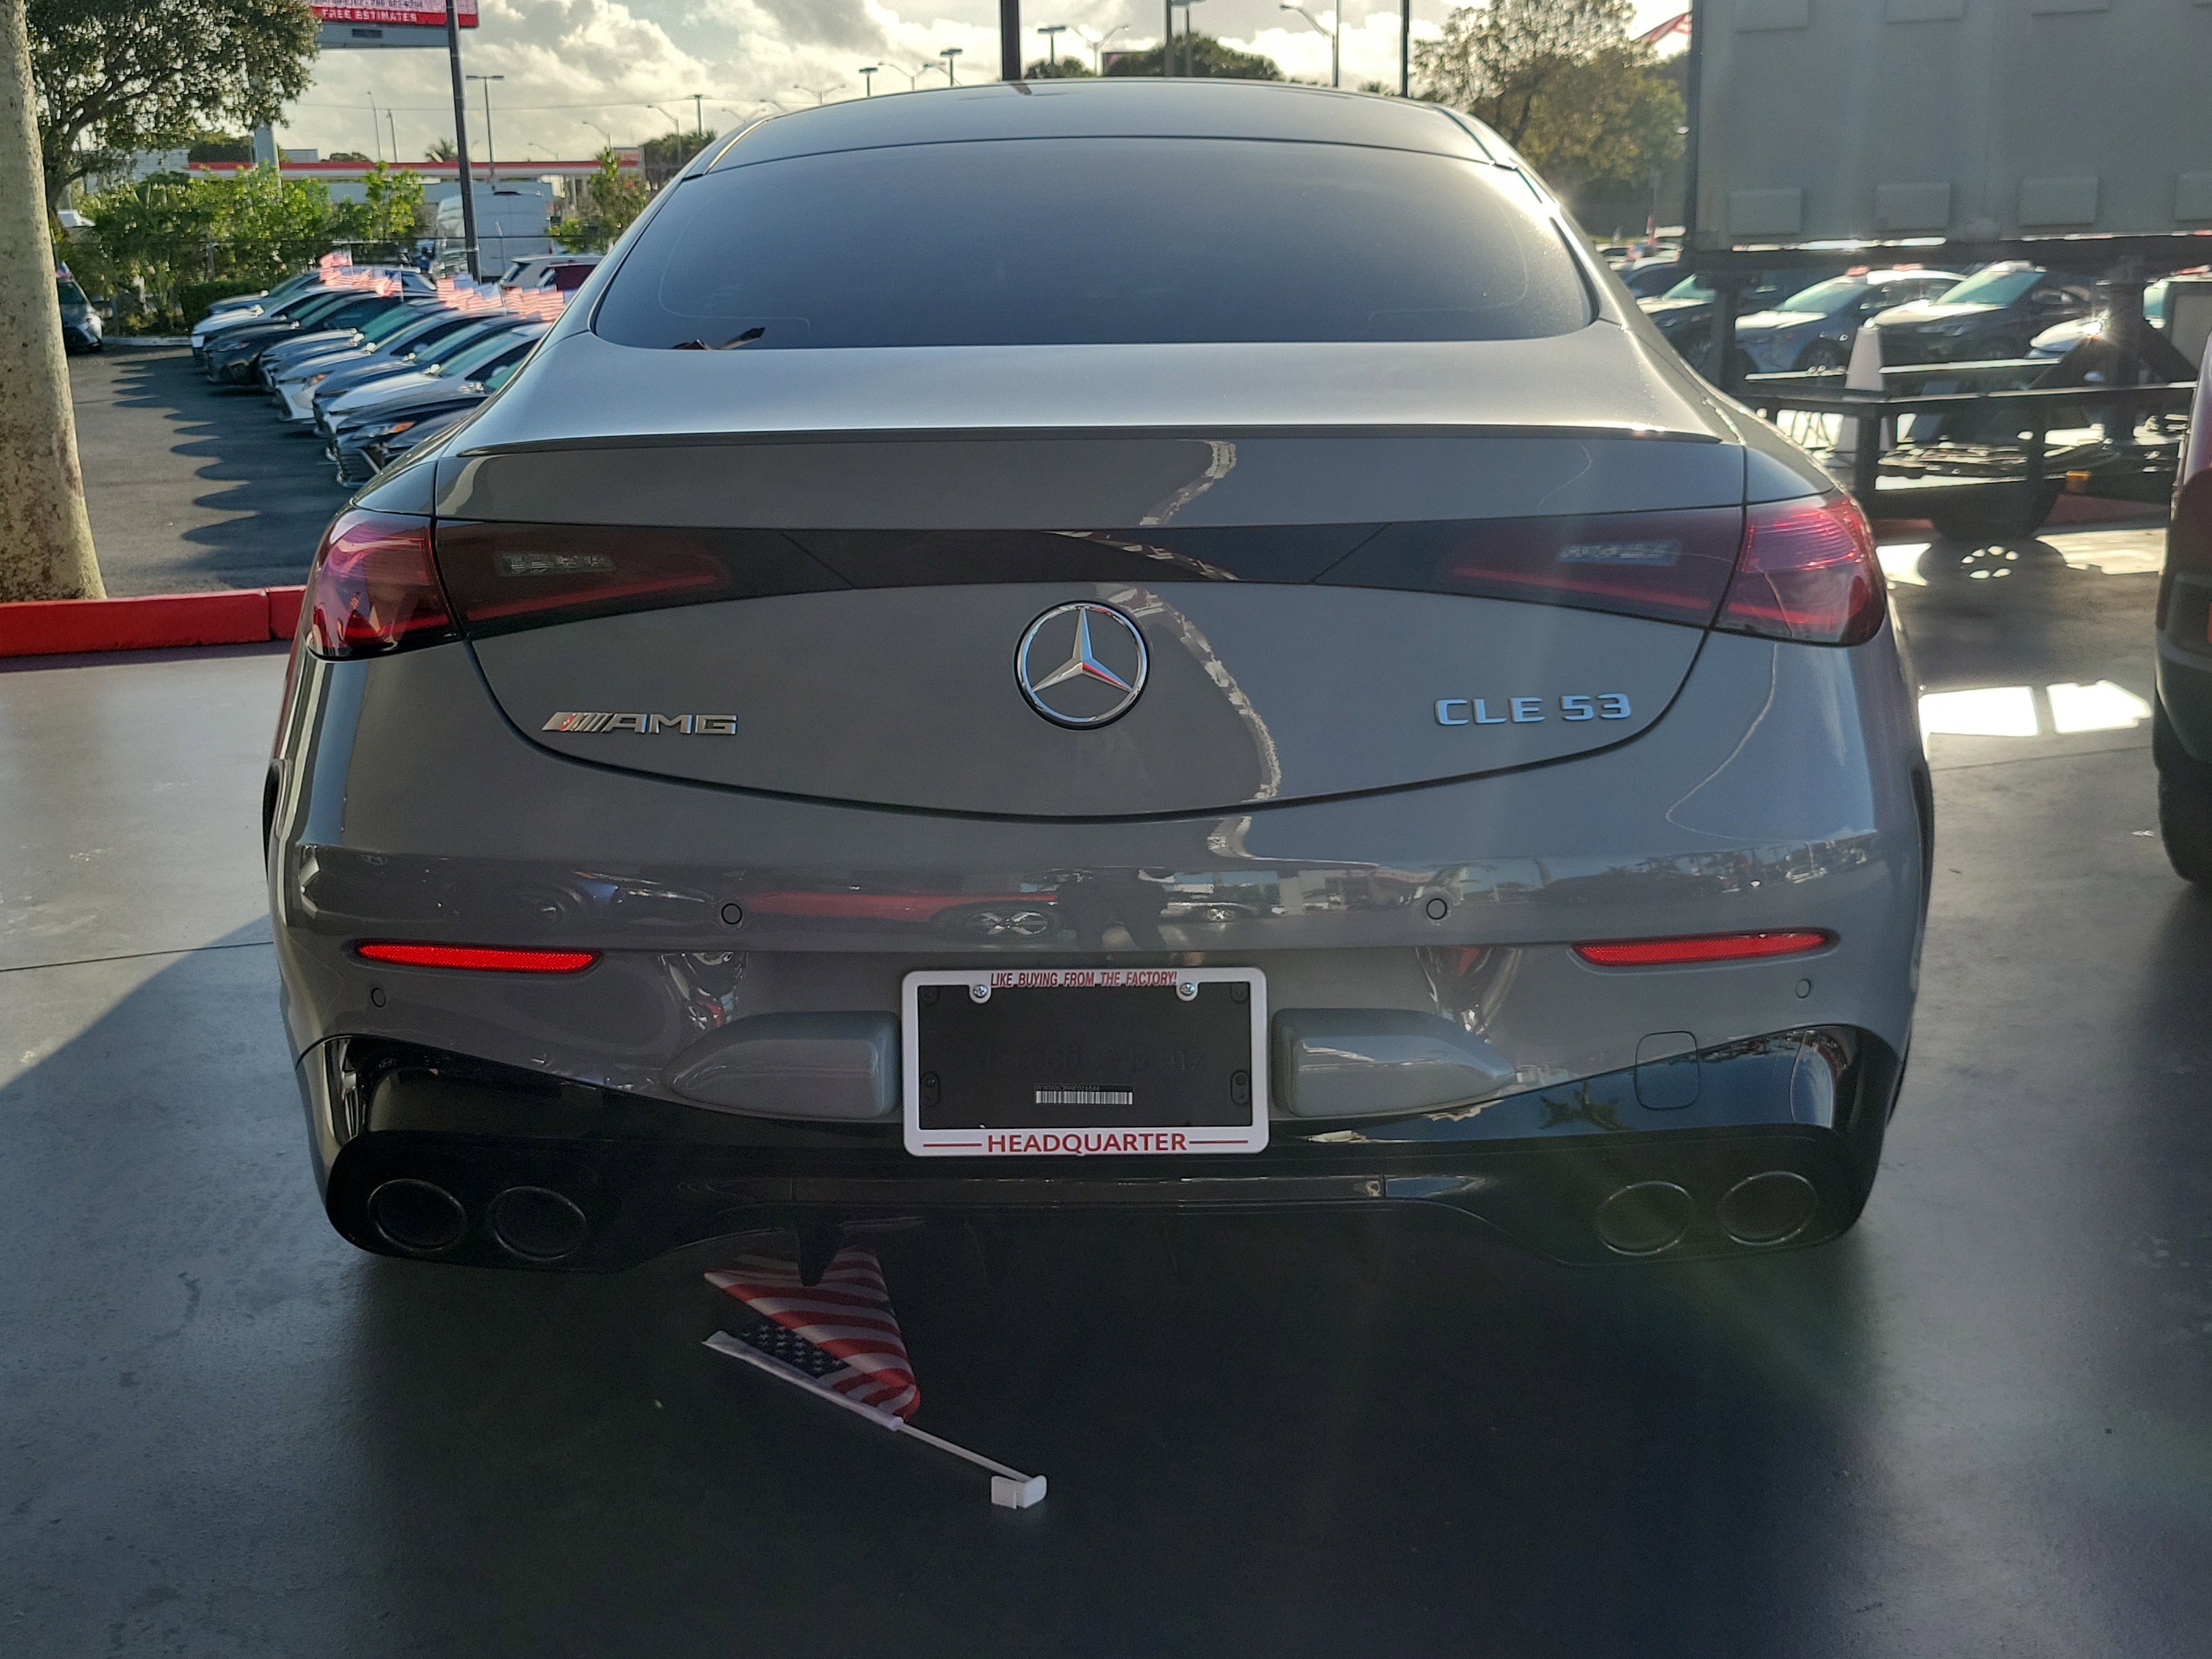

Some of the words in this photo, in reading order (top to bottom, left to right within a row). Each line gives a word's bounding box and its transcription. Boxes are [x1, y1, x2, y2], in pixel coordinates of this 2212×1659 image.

[323, 9, 351, 19] FREE
[356, 9, 417, 22] ESTIMATES
[1435, 697, 1545, 725] CLE
[1560, 693, 1631, 720] 53
[601, 713, 737, 735] AMG
[991, 973, 1013, 986] LIKE
[1018, 973, 1058, 986] BUYING
[1064, 972, 1094, 986] FROM
[1101, 972, 1120, 985] THE
[1126, 971, 1177, 985] FACTORY!
[988, 1133, 1187, 1154] HEADQUARTER
